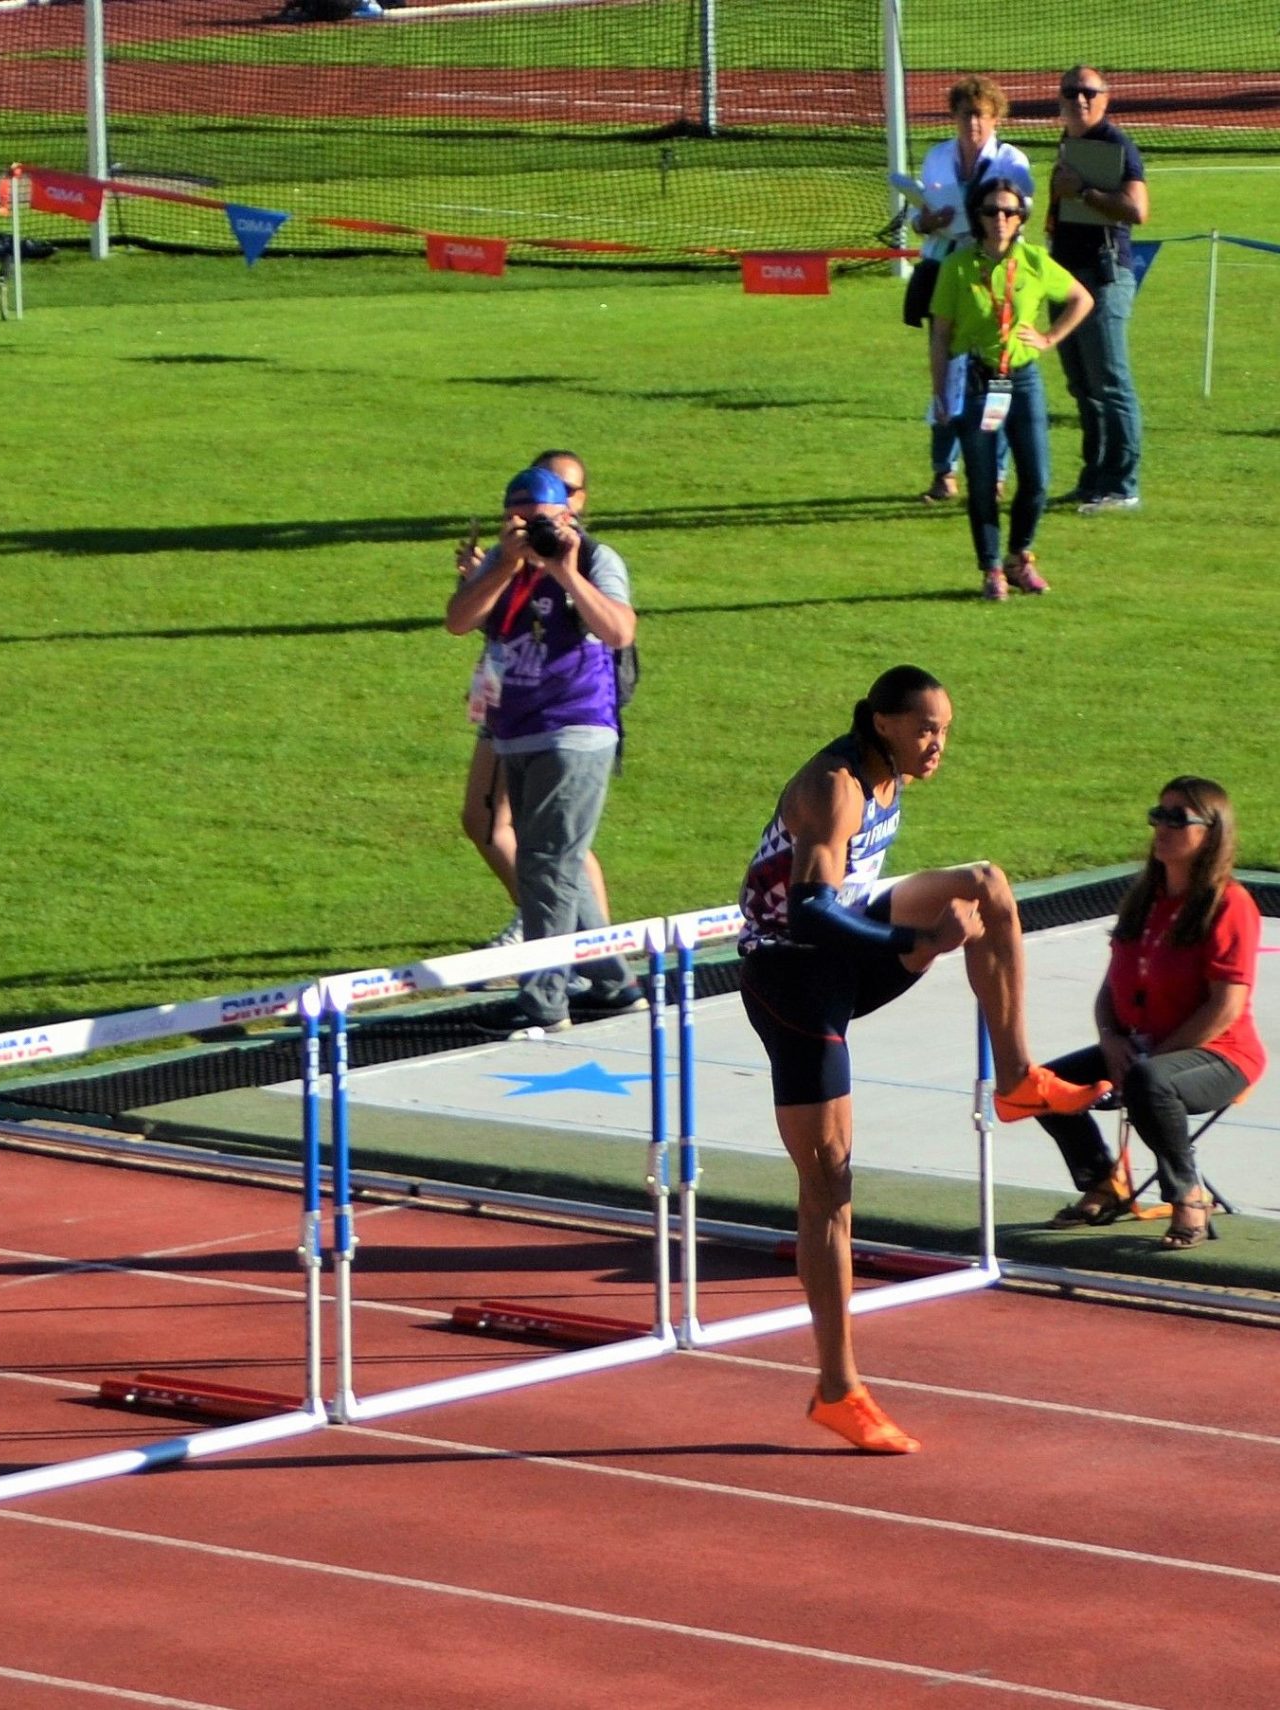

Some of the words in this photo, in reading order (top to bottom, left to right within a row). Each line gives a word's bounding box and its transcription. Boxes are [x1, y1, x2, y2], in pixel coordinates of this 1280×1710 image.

[574, 929, 637, 959] DIMA
[350, 970, 420, 999] DIMA
[222, 991, 289, 1023] DIMA
